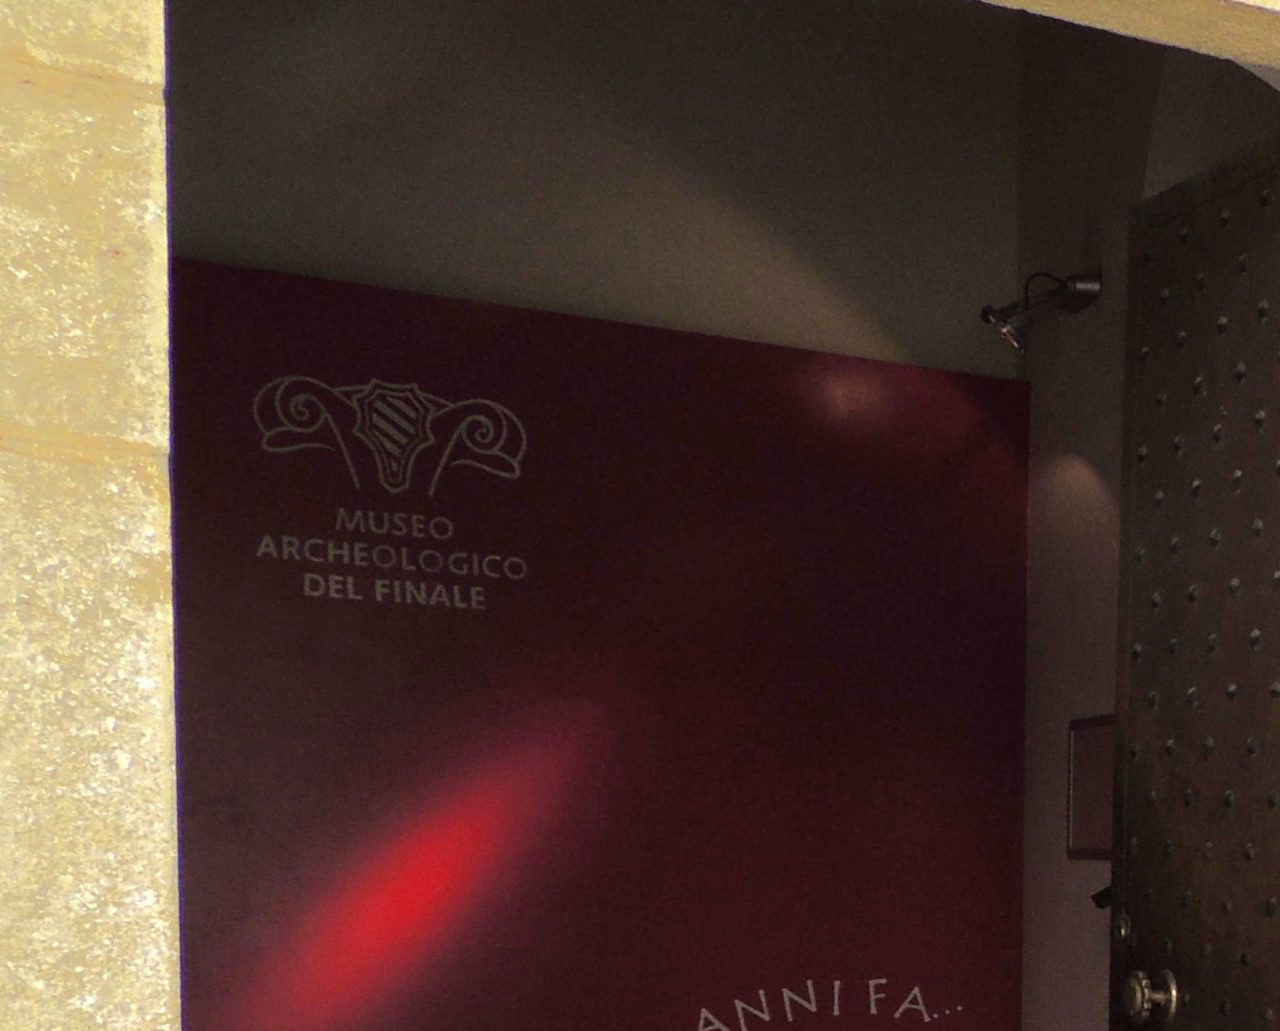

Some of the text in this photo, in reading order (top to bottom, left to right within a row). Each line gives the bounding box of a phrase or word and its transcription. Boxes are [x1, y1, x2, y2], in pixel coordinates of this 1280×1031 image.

[336, 507, 453, 540] MUSEO
[256, 534, 527, 579] ARCHEOLOGICO
[303, 573, 486, 610] DEL FINALE
